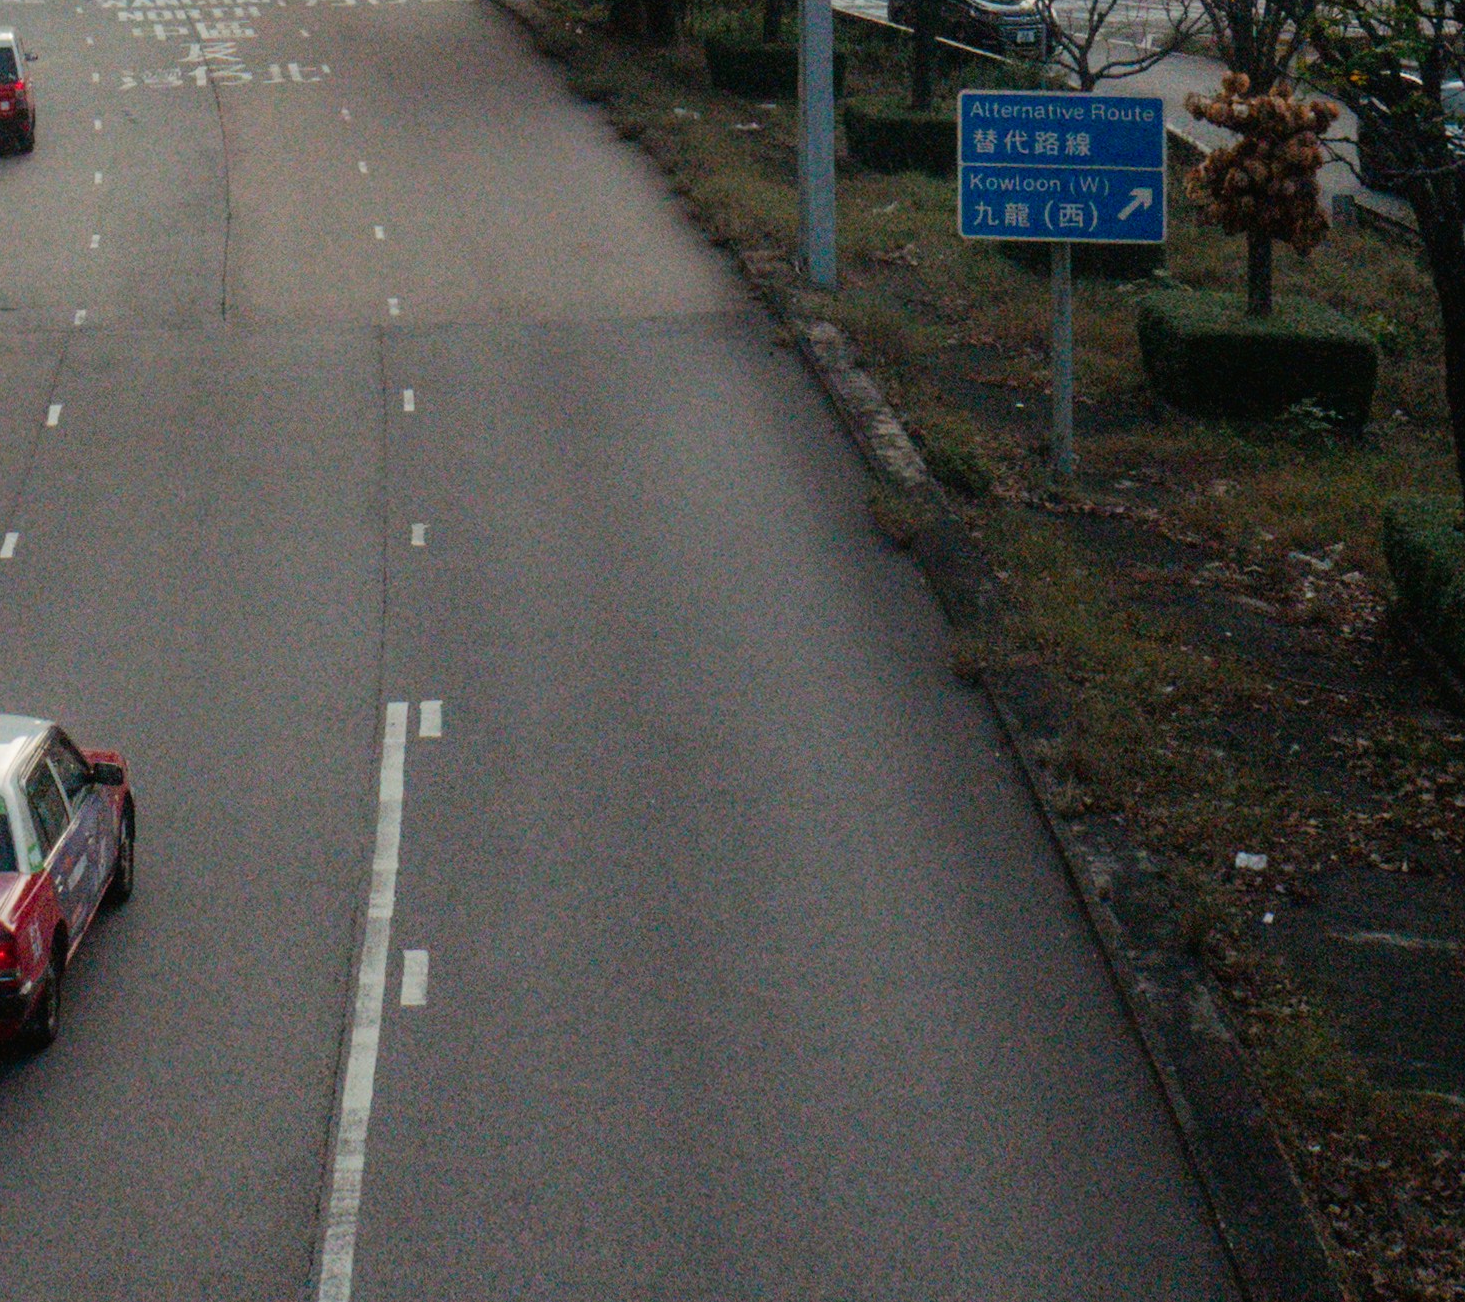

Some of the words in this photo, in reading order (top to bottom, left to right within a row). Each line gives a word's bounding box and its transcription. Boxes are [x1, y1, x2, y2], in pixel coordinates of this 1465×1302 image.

[970, 101, 1085, 120] Alternative
[1091, 104, 1155, 122] Route
[973, 128, 1091, 157] 替代路線
[970, 173, 1061, 192] Kowloon
[1070, 176, 1110, 196] (W)
